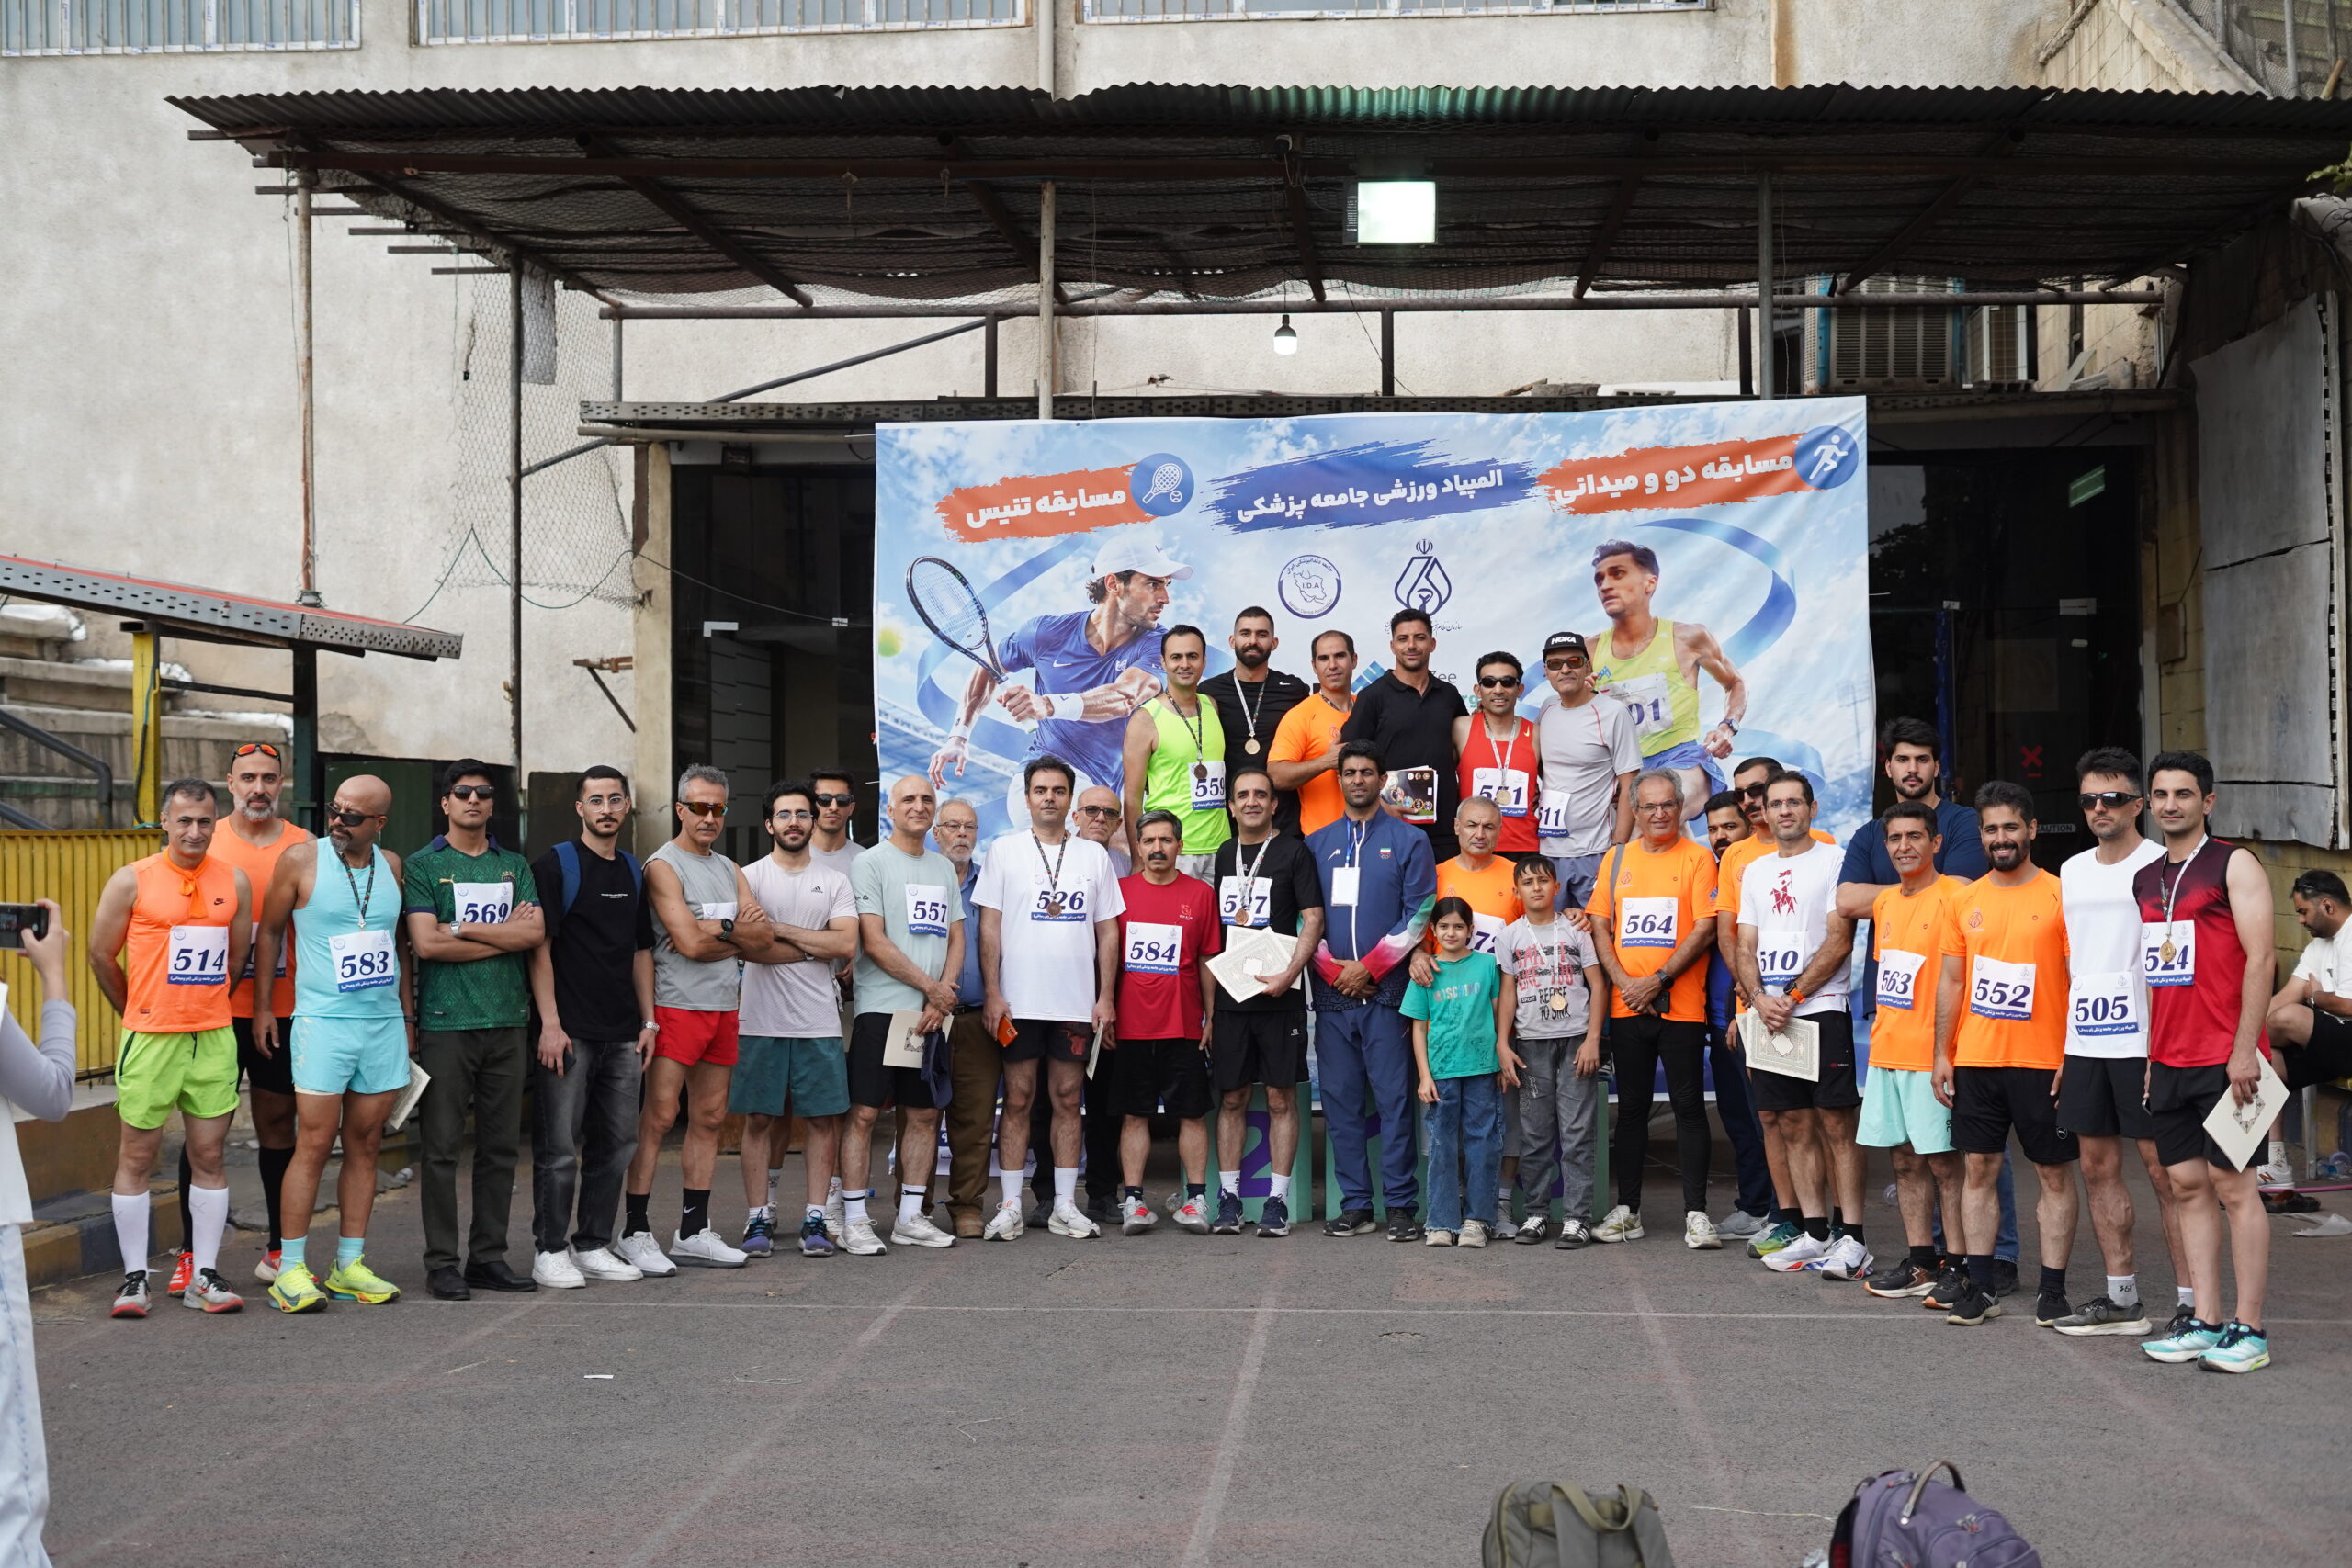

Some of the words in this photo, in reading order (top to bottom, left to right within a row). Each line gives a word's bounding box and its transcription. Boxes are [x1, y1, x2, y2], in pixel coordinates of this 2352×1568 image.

[1664, 465, 1697, 492] دو
[1702, 454, 1792, 482] مسابقه
[1374, 479, 1438, 506] ورزشی
[1441, 468, 1504, 499] المپیاد
[1555, 473, 1639, 505] میدانی
[1644, 472, 1659, 494] و
[1035, 488, 1126, 517] مسابقه
[1237, 492, 1306, 523] پزشکی
[1310, 487, 1369, 508] جامعه
[966, 496, 1032, 529] تنیس
[1551, 636, 1577, 645] HOKA
[1195, 777, 1225, 797] 559
[2037, 824, 2073, 832] AUTION
[913, 900, 947, 923] 557
[1037, 890, 1084, 910] 526
[1223, 894, 1268, 915] 57
[462, 902, 509, 924] 569
[1625, 914, 1673, 934] 564
[174, 948, 226, 972] 514
[341, 950, 390, 978] 583
[1130, 941, 1176, 963] 584
[1881, 969, 1912, 995] 563
[1974, 978, 2030, 1008] 552
[2075, 995, 2129, 1022] 505
